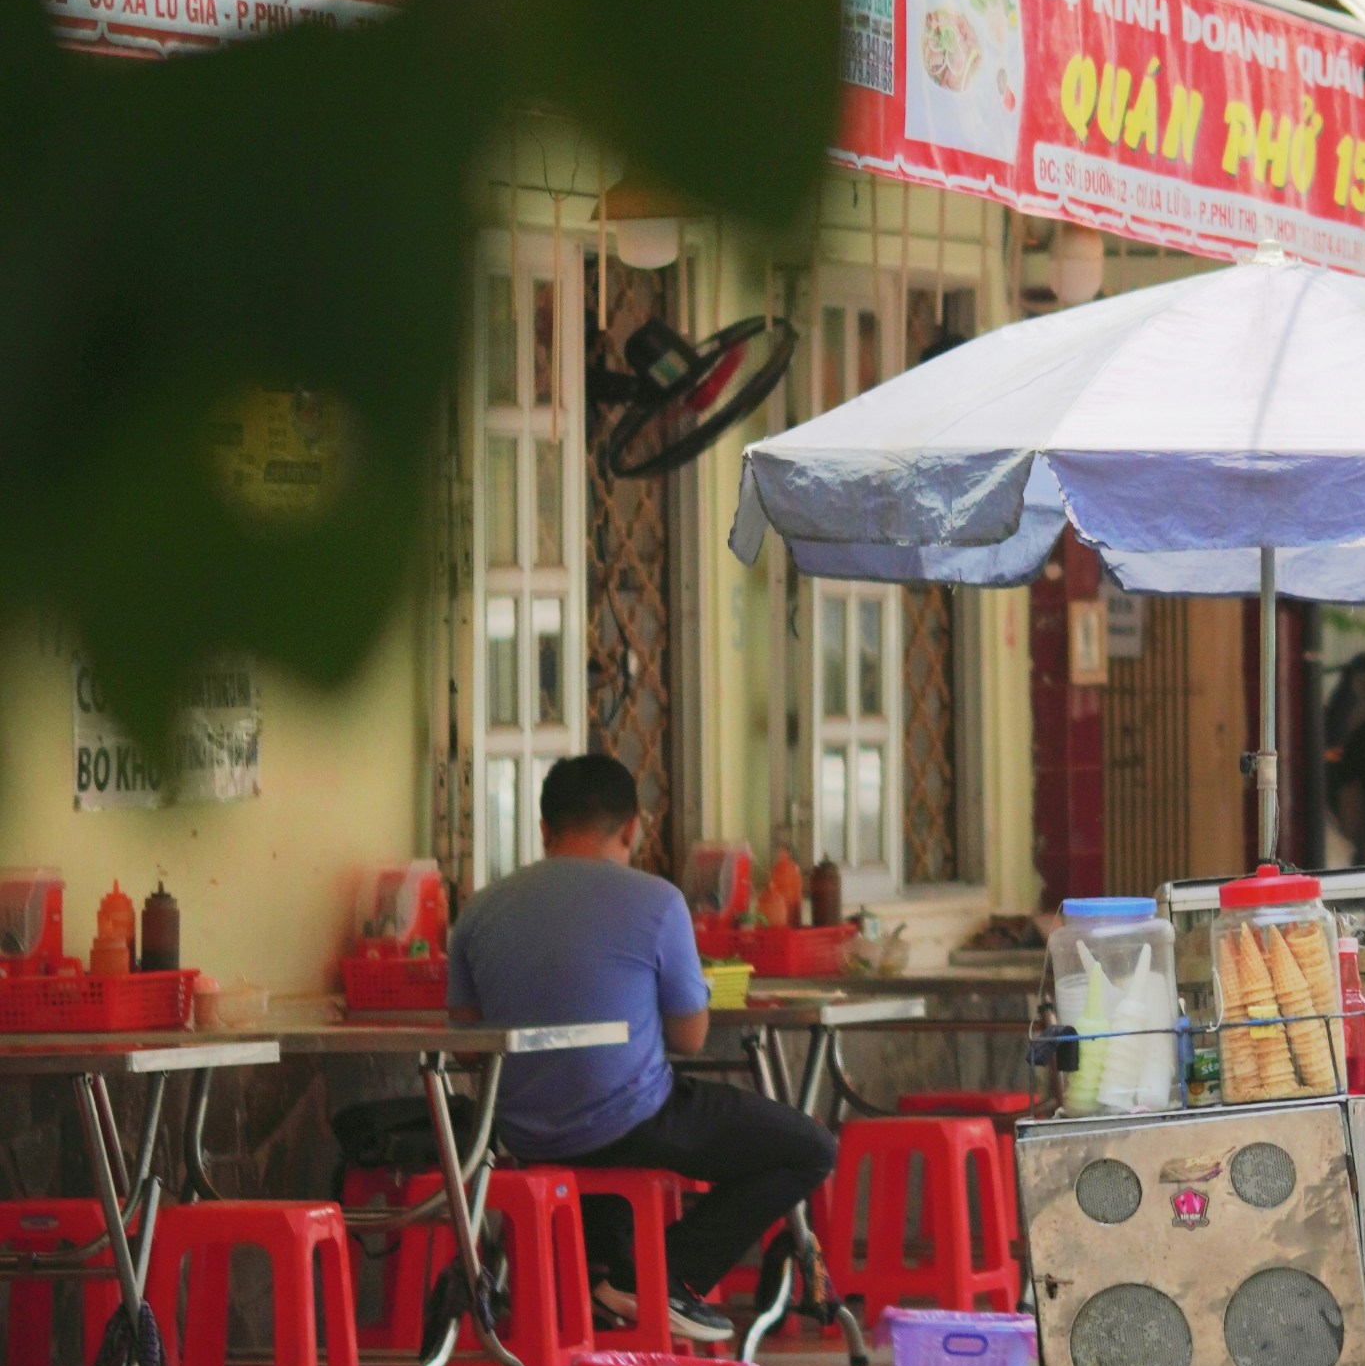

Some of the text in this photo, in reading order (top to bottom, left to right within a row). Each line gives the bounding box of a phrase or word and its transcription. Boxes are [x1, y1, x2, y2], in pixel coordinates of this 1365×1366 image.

[1182, 4, 1287, 71] DOANH
[1296, 43, 1365, 100] QUÁN
[1061, 53, 1204, 168] QUÁN
[1221, 93, 1324, 196] PHỞ
